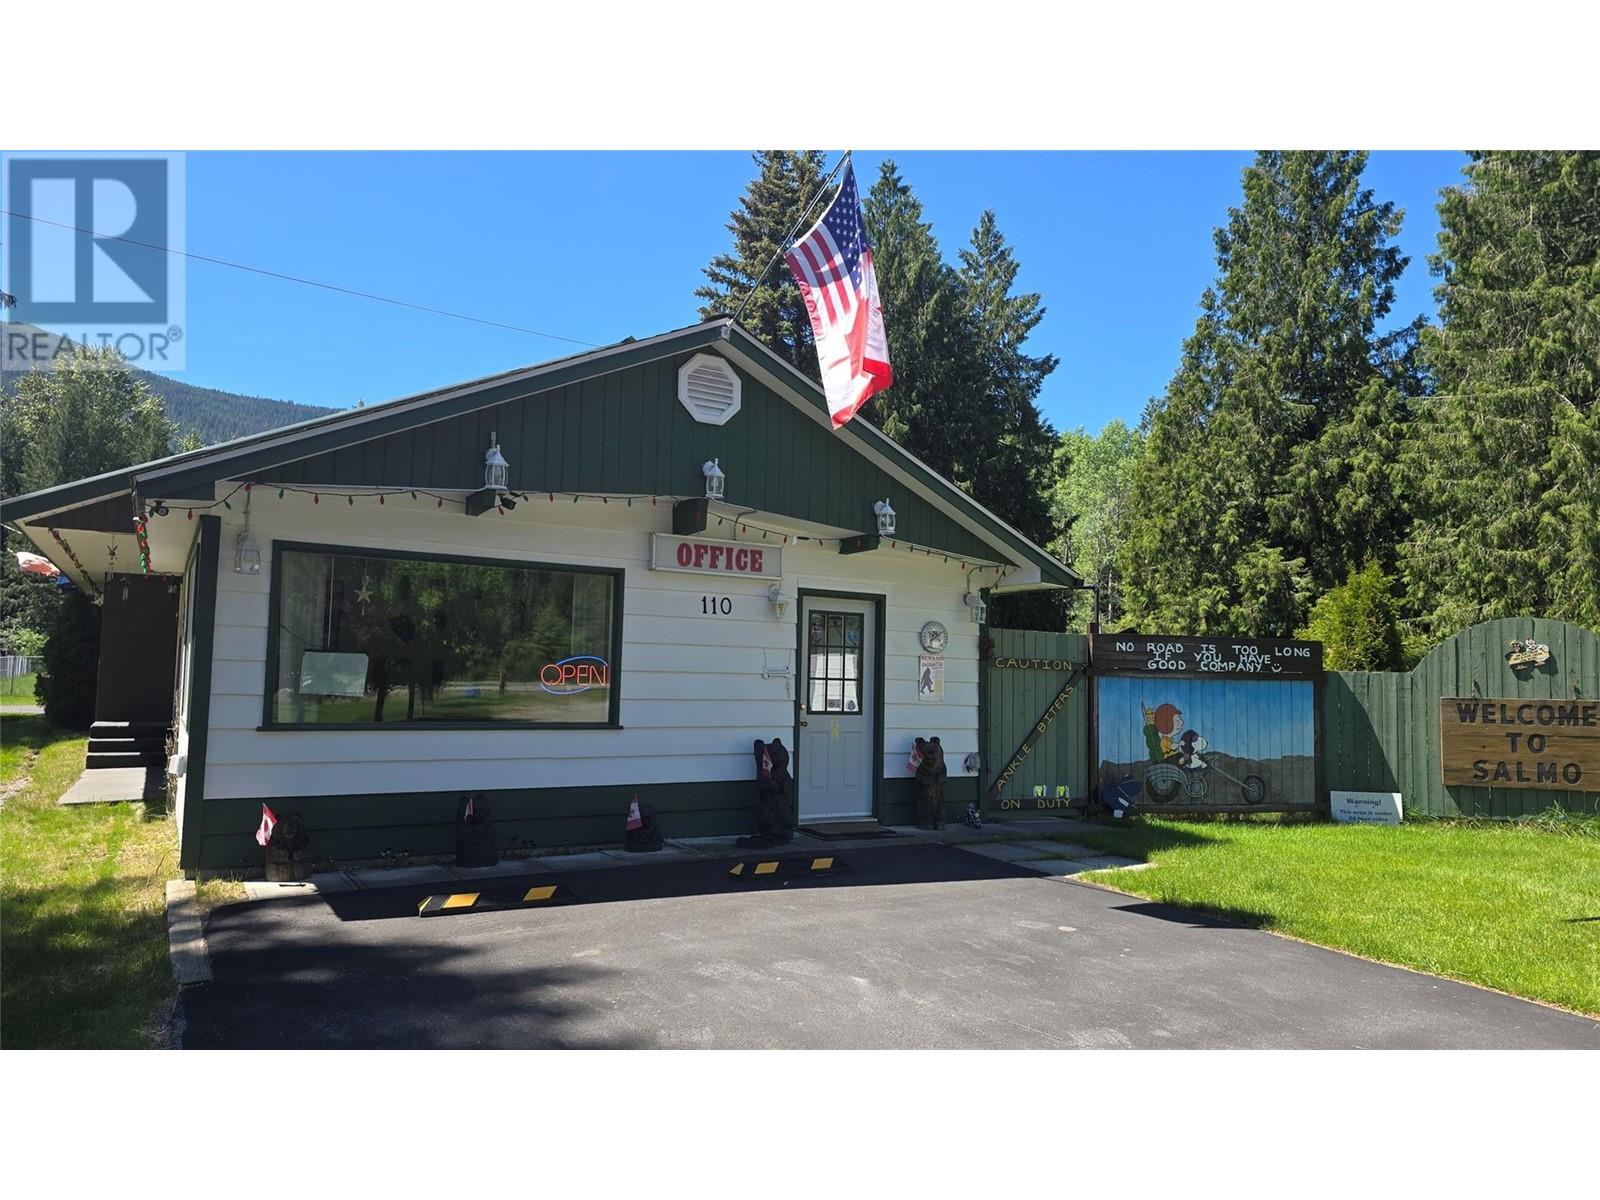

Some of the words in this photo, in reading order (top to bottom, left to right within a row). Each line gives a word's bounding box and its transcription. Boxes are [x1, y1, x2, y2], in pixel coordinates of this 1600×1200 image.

[676, 542, 763, 572] OFFICE
[701, 596, 732, 615] 110
[1116, 642, 1135, 652] NO
[1146, 643, 1184, 653] ROAD
[1232, 645, 1258, 655] TOO
[1275, 647, 1311, 657] LONG
[1153, 652, 1171, 661] IF
[1194, 652, 1222, 662] YOU
[1240, 653, 1271, 664] HAVE
[995, 657, 1072, 671] CAUTION
[1147, 660, 1186, 670] GOOD
[1200, 661, 1262, 672] COMPANY
[540, 664, 606, 687] OPEN
[1456, 702, 1598, 727] WELCOME
[996, 743, 1032, 791] ANKLE
[1037, 684, 1074, 733] BITERS
[1505, 732, 1546, 754] TO
[1472, 759, 1582, 785] SALMO
[1001, 799, 1021, 810] ON
[1037, 799, 1071, 809] DUTY
[1346, 798, 1382, 806] Warning!
